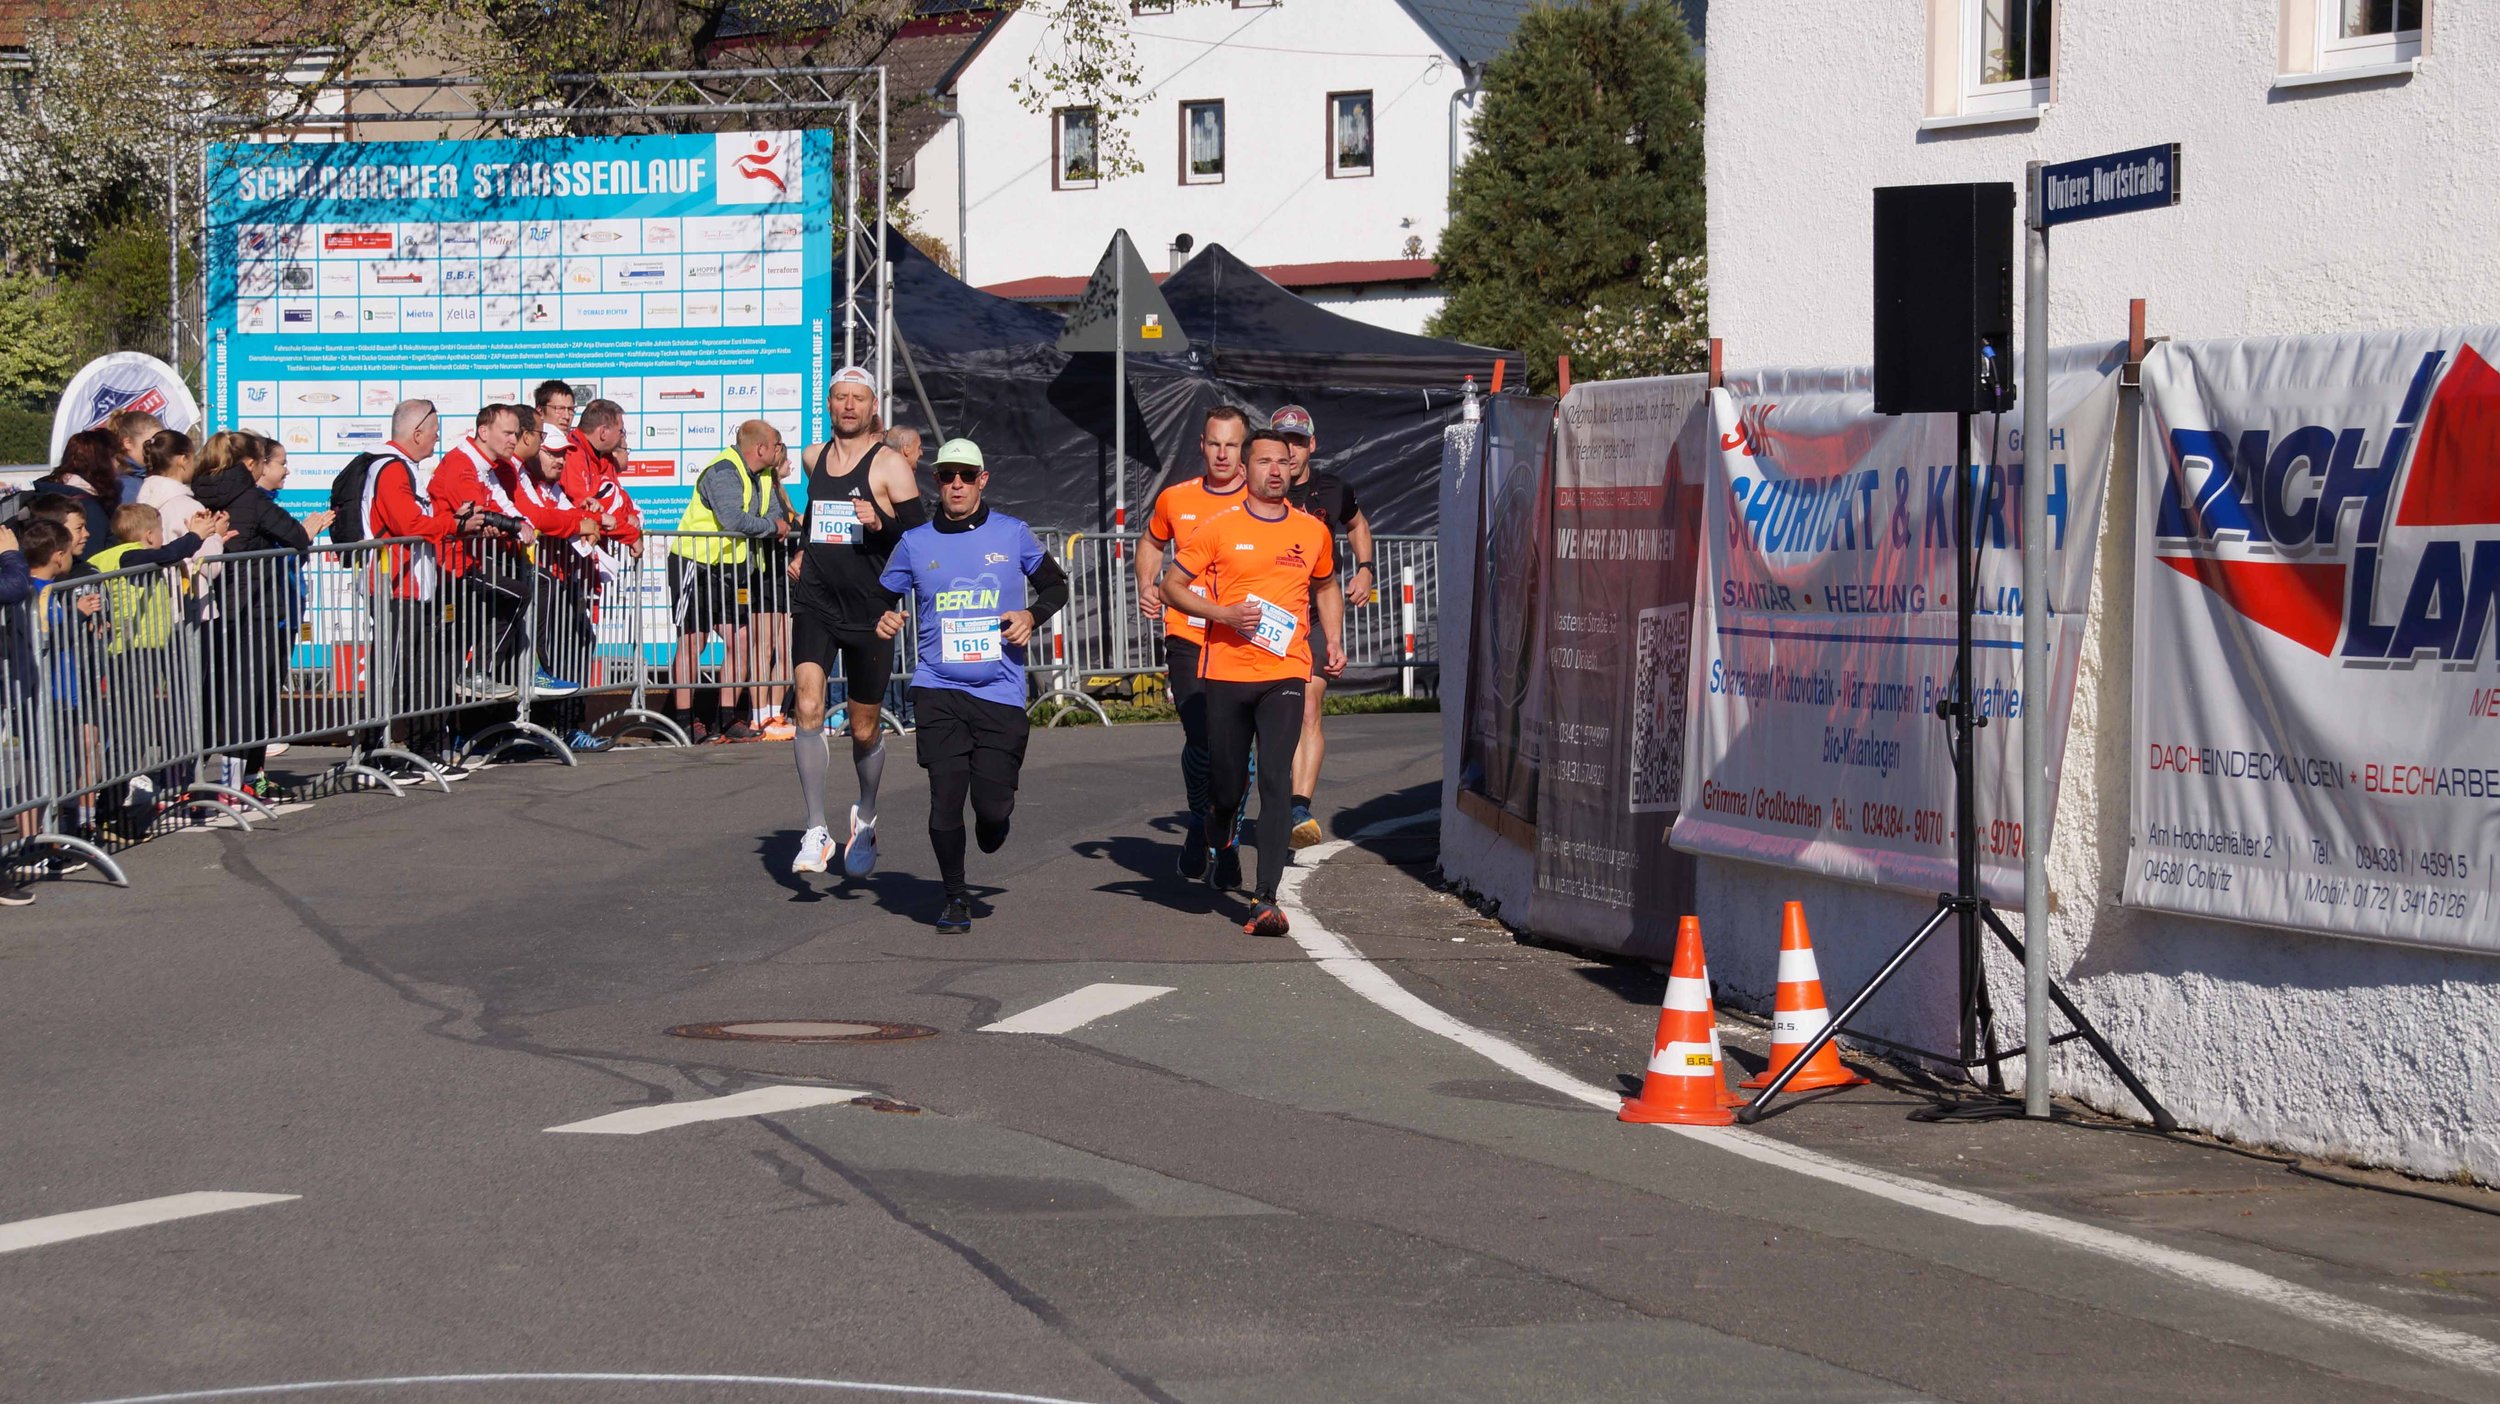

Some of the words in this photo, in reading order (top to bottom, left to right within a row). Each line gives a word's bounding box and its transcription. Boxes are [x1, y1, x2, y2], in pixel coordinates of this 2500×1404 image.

[238, 159, 458, 201] SCHÖNBACHER
[474, 158, 706, 199] STRASSENLAUF
[2048, 175, 2090, 210] Untere
[2093, 157, 2164, 203] Dorfstraße
[445, 271, 476, 280] B.B.F.
[767, 266, 799, 274] terraform
[406, 309, 433, 318] Mietra
[447, 308, 476, 320] Xella
[727, 386, 758, 395] B.B.F.
[812, 317, 823, 444] CHER-STRASSENLAUF.DE
[98, 393, 116, 413] SV
[688, 425, 715, 434] Mietra
[2156, 352, 2443, 553] DACH
[1892, 466, 1912, 549] &
[818, 520, 853, 535] 1608
[1235, 543, 1254, 551] JAKO
[1609, 528, 1676, 560] BEDACHUNGEN
[935, 589, 1000, 613] BERLIN
[1722, 579, 1797, 615] SANITÄR
[1825, 584, 1925, 613] HEIZUNG
[953, 637, 990, 653] 1616
[1256, 622, 1282, 642] 615
[1775, 666, 1834, 706] Photovoltaik
[2150, 743, 2345, 790] DACHEINDECKUNGEN
[1703, 779, 1747, 816] Grimma
[1756, 788, 1822, 828] Großbothen
[1862, 801, 1903, 840] 034384
[1914, 809, 1943, 845] 9070
[2148, 822, 2170, 847] Am
[2173, 825, 2260, 857] Hochbehälter
[2264, 836, 2273, 859] 2
[2144, 859, 2184, 886] 04680
[2187, 863, 2232, 891] Colditz
[2312, 840, 2332, 865] Tel.
[2355, 844, 2405, 873] 034381
[2420, 852, 2467, 879] 45915
[2304, 878, 2348, 906] Mobil:
[2353, 884, 2390, 911] 0172
[2401, 889, 2467, 919] 3416126
